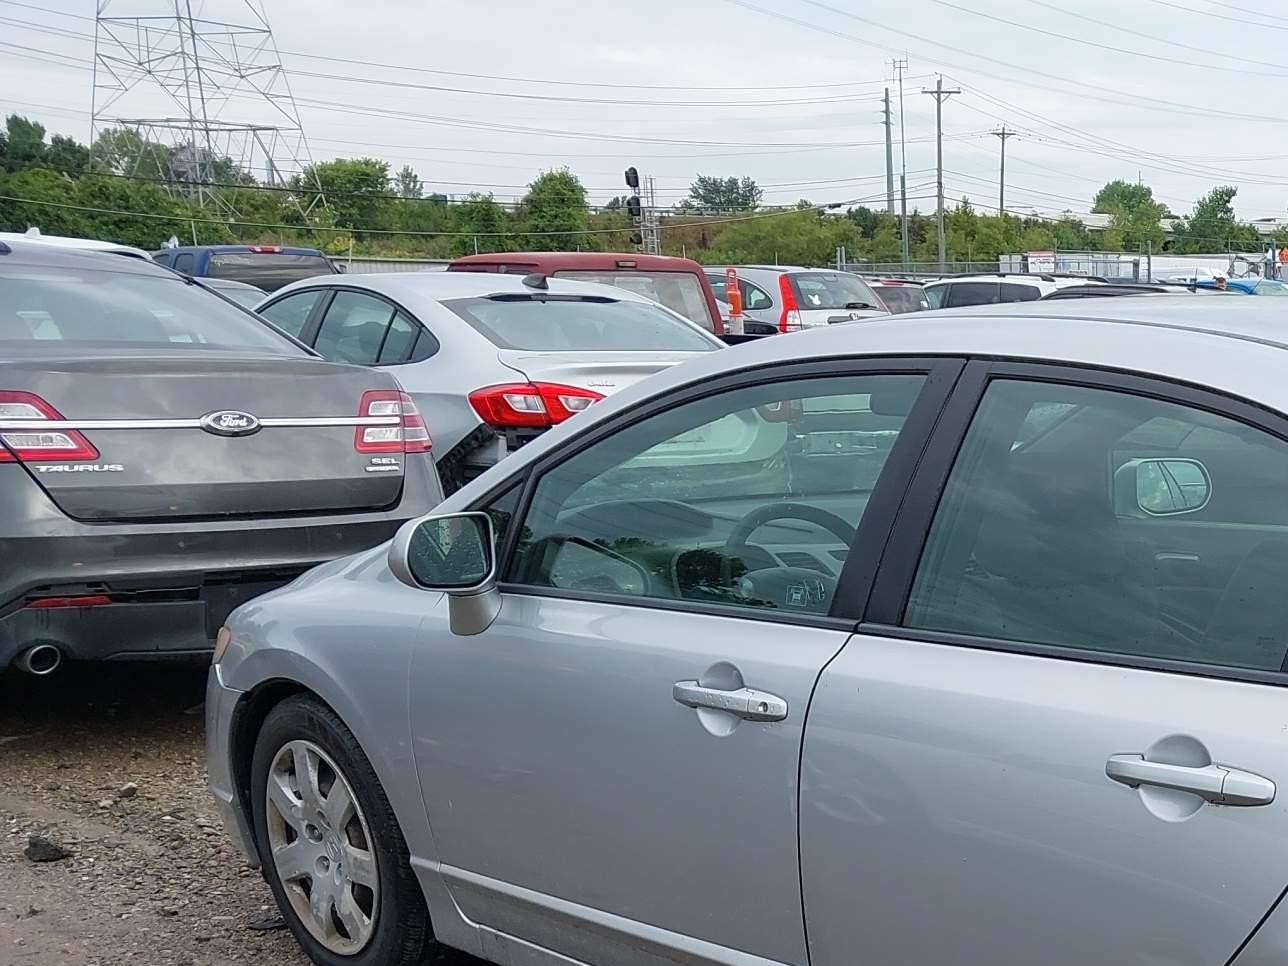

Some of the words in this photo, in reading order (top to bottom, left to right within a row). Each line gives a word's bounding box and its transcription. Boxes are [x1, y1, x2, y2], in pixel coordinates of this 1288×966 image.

[220, 414, 248, 427] Ford
[371, 457, 401, 465] SEL
[35, 464, 125, 473] TAURUS
